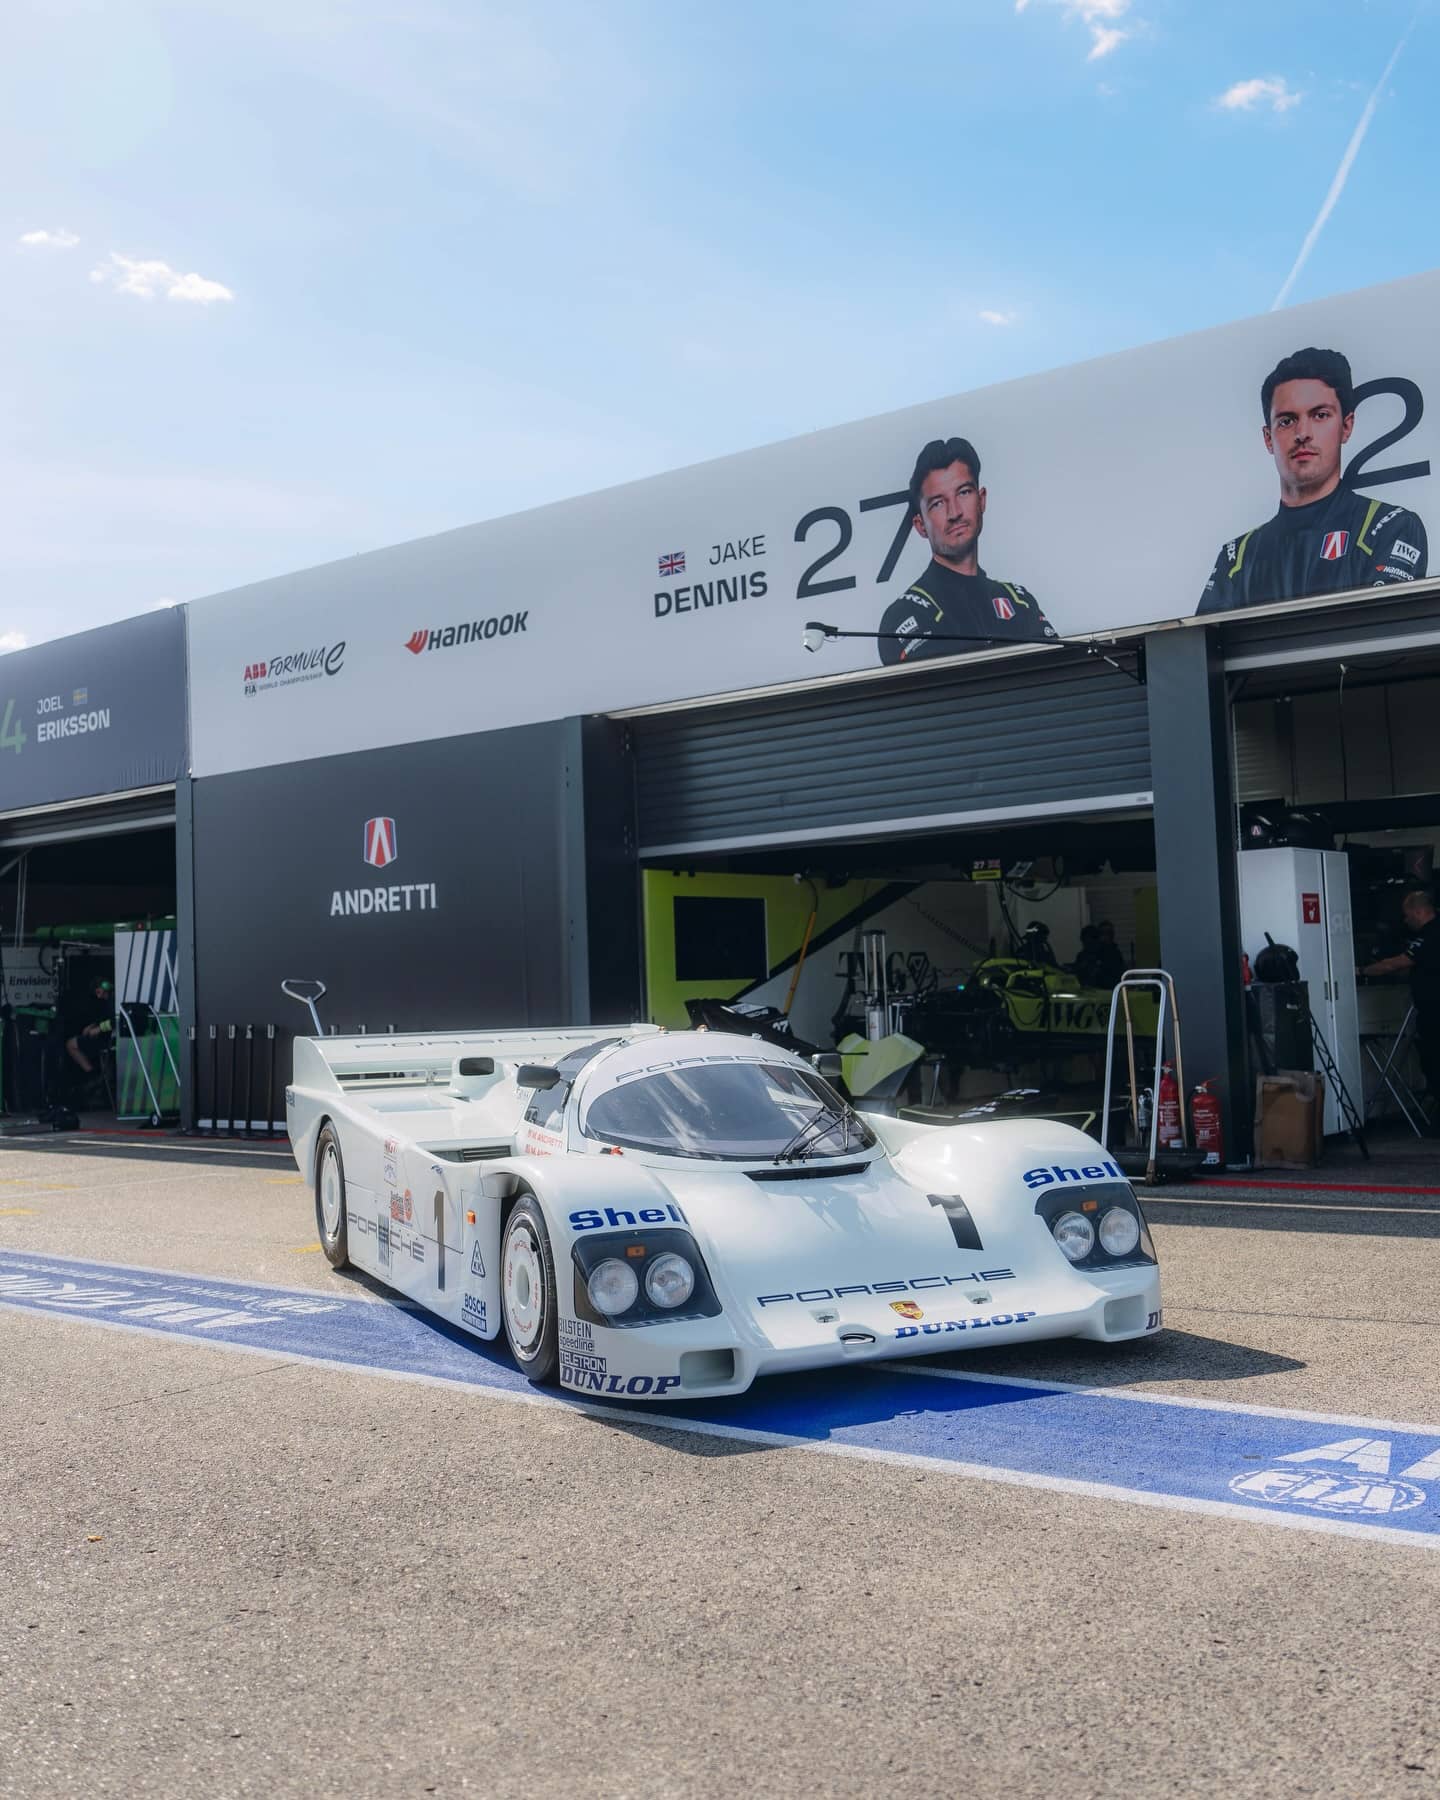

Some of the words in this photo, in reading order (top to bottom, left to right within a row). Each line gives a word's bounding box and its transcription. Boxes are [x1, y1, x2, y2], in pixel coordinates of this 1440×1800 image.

[708, 534, 767, 566] JAKE
[792, 488, 917, 600] 27
[653, 570, 769, 618] DENNIS
[243, 661, 267, 682] ABB
[267, 645, 326, 679] FORMULA
[36, 695, 64, 715] JOEL
[244, 684, 257, 696] FIA
[36, 708, 111, 743] ERIKSSON
[330, 881, 438, 918] ANDRETTI
[347, 1212, 425, 1263] PORSCHE
[926, 1193, 984, 1251] 1
[433, 1190, 446, 1292] 1
[464, 1292, 487, 1317] BOSCH
[756, 1268, 1017, 1308] PORSCHE
[559, 1317, 592, 1339] BILSTEIN
[894, 1311, 1037, 1340] DUNLOP
[561, 1365, 681, 1395] DUNLOP
